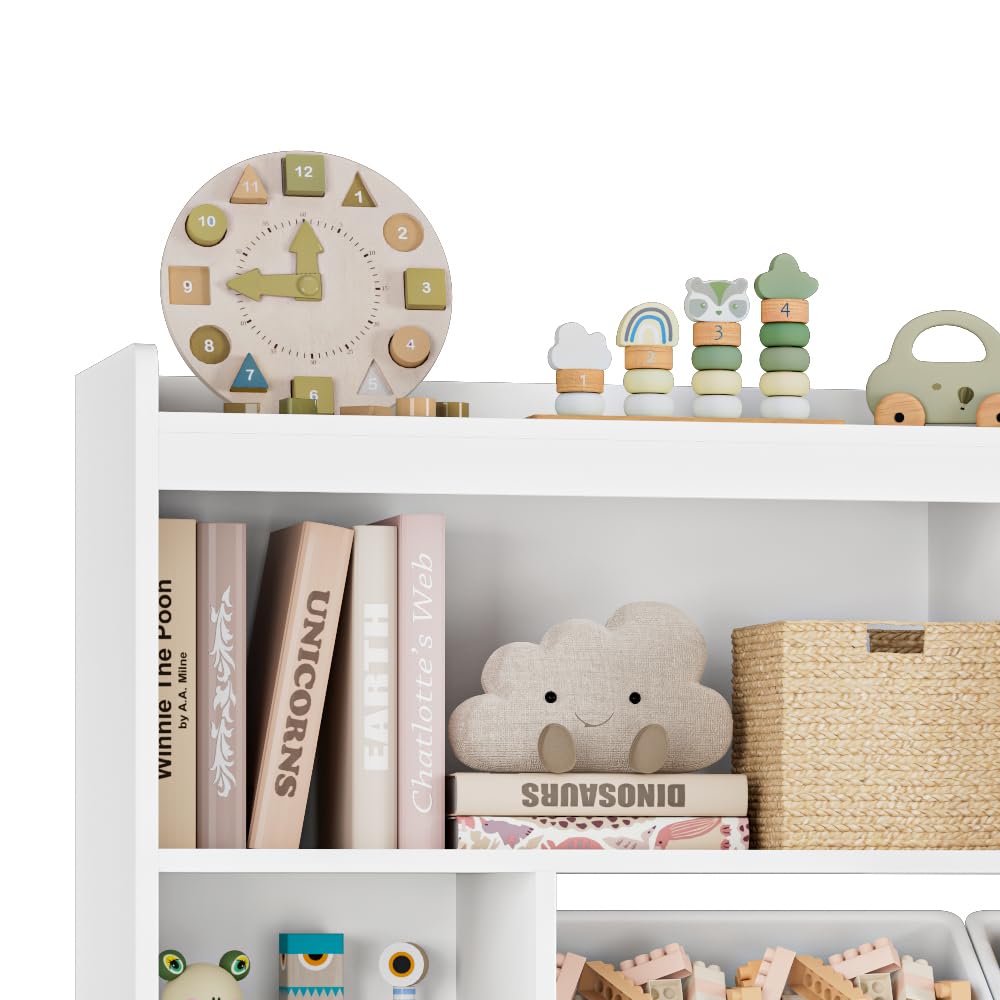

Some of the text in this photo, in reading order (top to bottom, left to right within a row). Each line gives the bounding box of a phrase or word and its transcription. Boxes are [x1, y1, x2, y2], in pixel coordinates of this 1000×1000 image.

[294, 166, 314, 179] 12
[242, 181, 259, 193] 11
[354, 191, 363, 203] 1
[197, 215, 217, 227] 10
[397, 226, 409, 240] 2
[182, 281, 193, 293] 9
[421, 281, 432, 293] 3
[779, 302, 791, 319] 4
[712, 324, 724, 341] 3
[203, 339, 215, 352] 8
[405, 339, 416, 350] 4
[646, 350, 656, 363] 2
[245, 369, 255, 381] 7
[578, 374, 587, 386] 1
[368, 378, 378, 390] 5
[309, 389, 318, 401] 6
[410, 552, 433, 624] Web
[178, 652, 190, 729] by A.A. Milne
[363, 603, 389, 771] EARTH
[274, 590, 331, 798] UNICORNS
[521, 782, 686, 808] DINOSAURS
